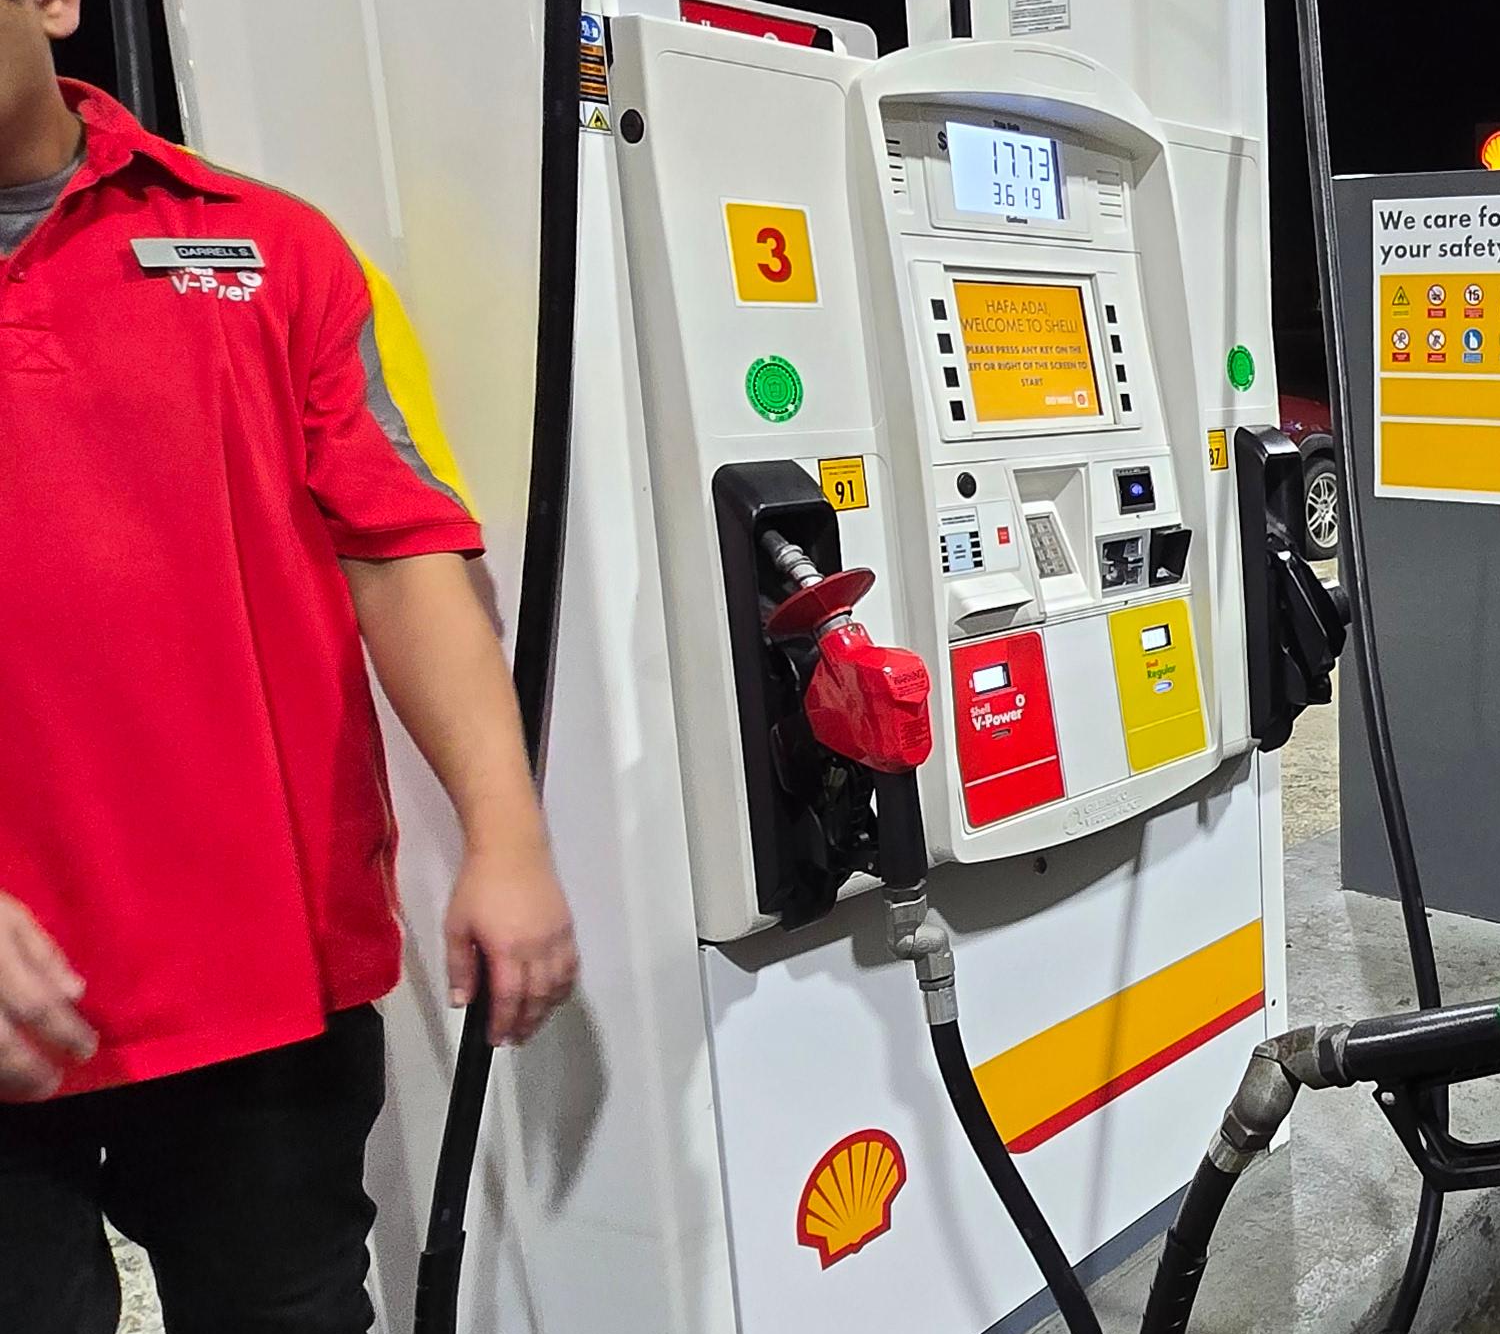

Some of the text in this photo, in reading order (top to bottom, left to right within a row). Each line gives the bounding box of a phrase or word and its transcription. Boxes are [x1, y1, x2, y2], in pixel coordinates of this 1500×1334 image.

[992, 140, 1050, 182] 17.73
[1379, 210, 1416, 230] We
[1423, 213, 1472, 229] care
[179, 247, 237, 257] DARRELL
[756, 227, 793, 283] 3
[1380, 243, 1432, 265] your
[985, 299, 1018, 314] HAFA
[960, 317, 1025, 332] WELCOME
[1026, 318, 1042, 333] TO
[966, 346, 994, 355] PLEASE
[996, 346, 1020, 355] PRESS
[1020, 378, 1043, 387] START
[834, 480, 855, 504] 91
[970, 703, 991, 717] Shell
[972, 709, 1025, 731] V-Power
